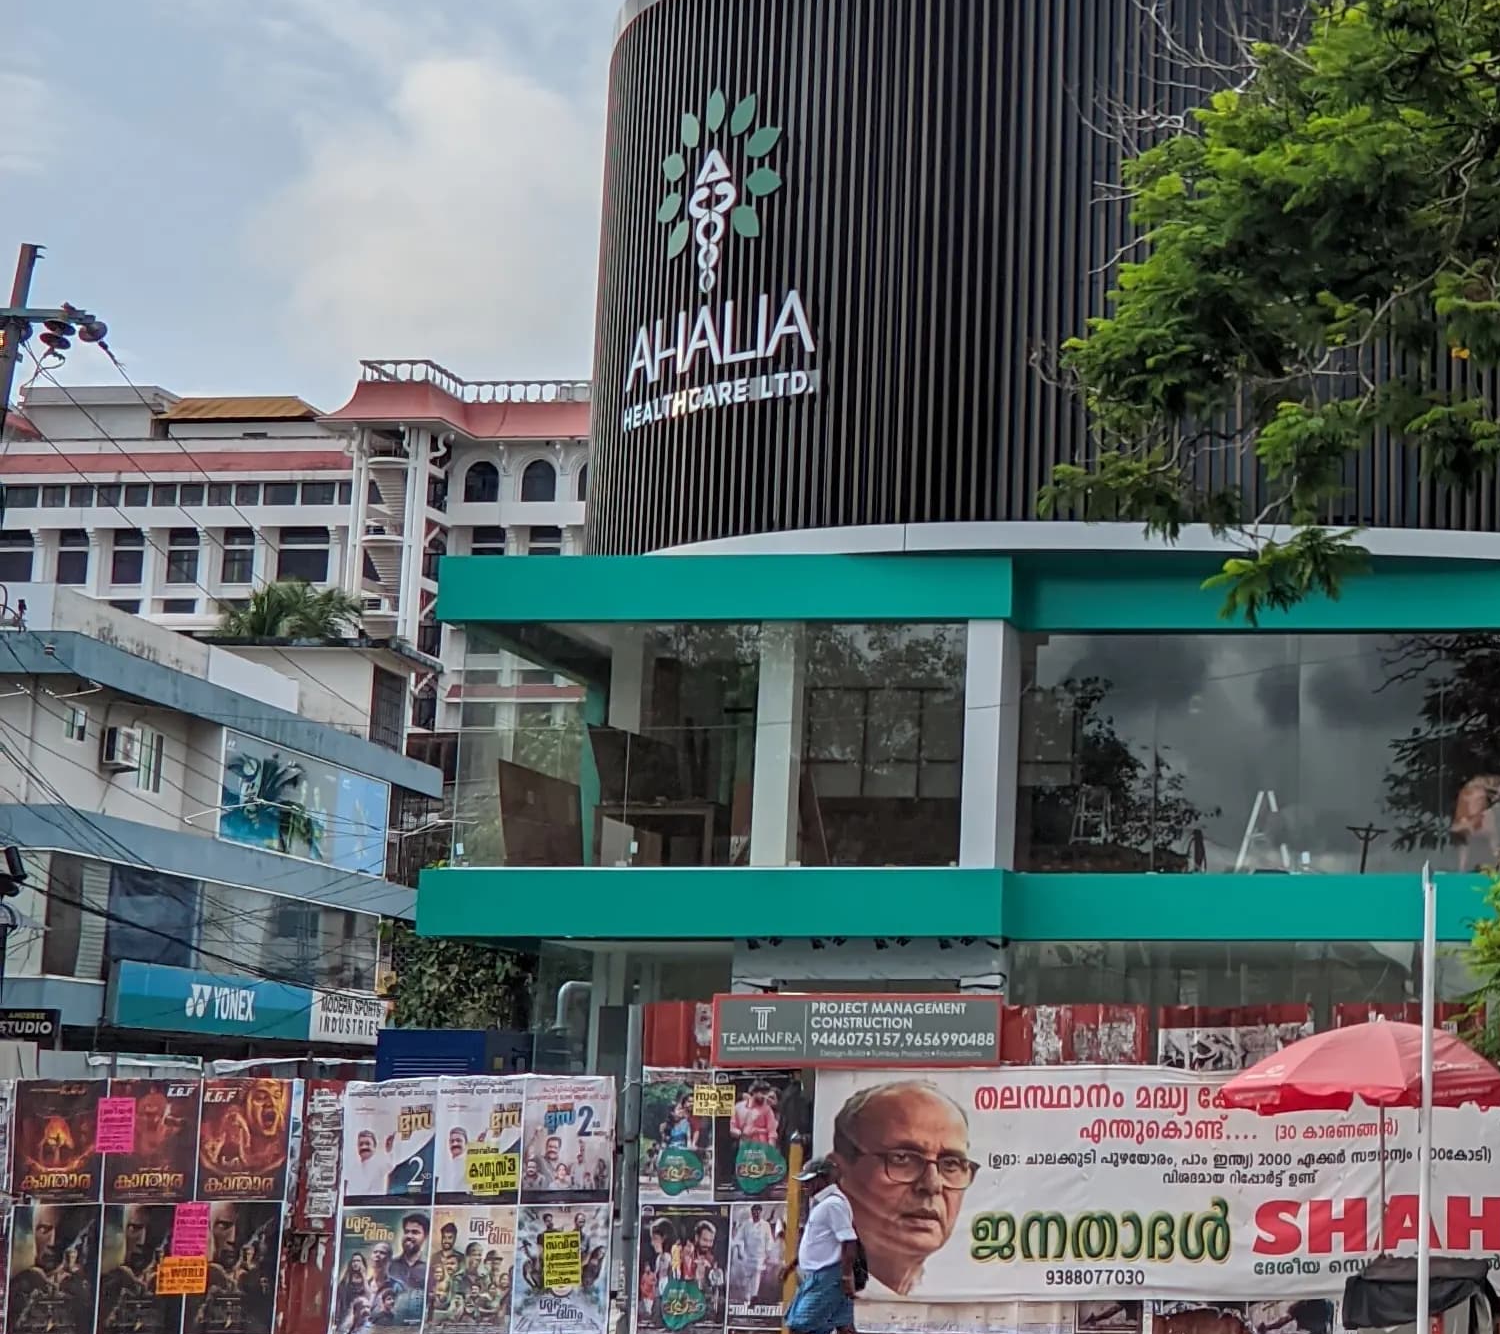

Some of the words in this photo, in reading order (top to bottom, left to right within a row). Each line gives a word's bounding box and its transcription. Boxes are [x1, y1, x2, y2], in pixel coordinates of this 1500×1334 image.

[625, 289, 816, 393] AHALIA
[623, 381, 748, 433] HEALTHCARE
[214, 989, 256, 1021] YONEX
[354, 999, 384, 1017] SPORTS
[811, 1002, 868, 1015] PROJECT
[871, 1002, 967, 1015] MANAGEMENT
[0, 1021, 52, 1035] STUDIO
[319, 1016, 380, 1037] INDUSTRIES
[811, 1016, 913, 1029] CONSTRUCTION
[721, 1031, 802, 1046] TEAMINFRA
[974, 1083, 1124, 1110] തലസ്ഥാനം
[1025, 1149, 1097, 1167] ചാലക്കുടി
[1258, 1153, 1292, 1166] 2000
[1162, 1169, 1224, 1184] വിശദമായ
[970, 1197, 1233, 1263] ജനതാദൾ
[1253, 1257, 1321, 1275] ദേശീയ
[1045, 1268, 1145, 1286] 9388077030
